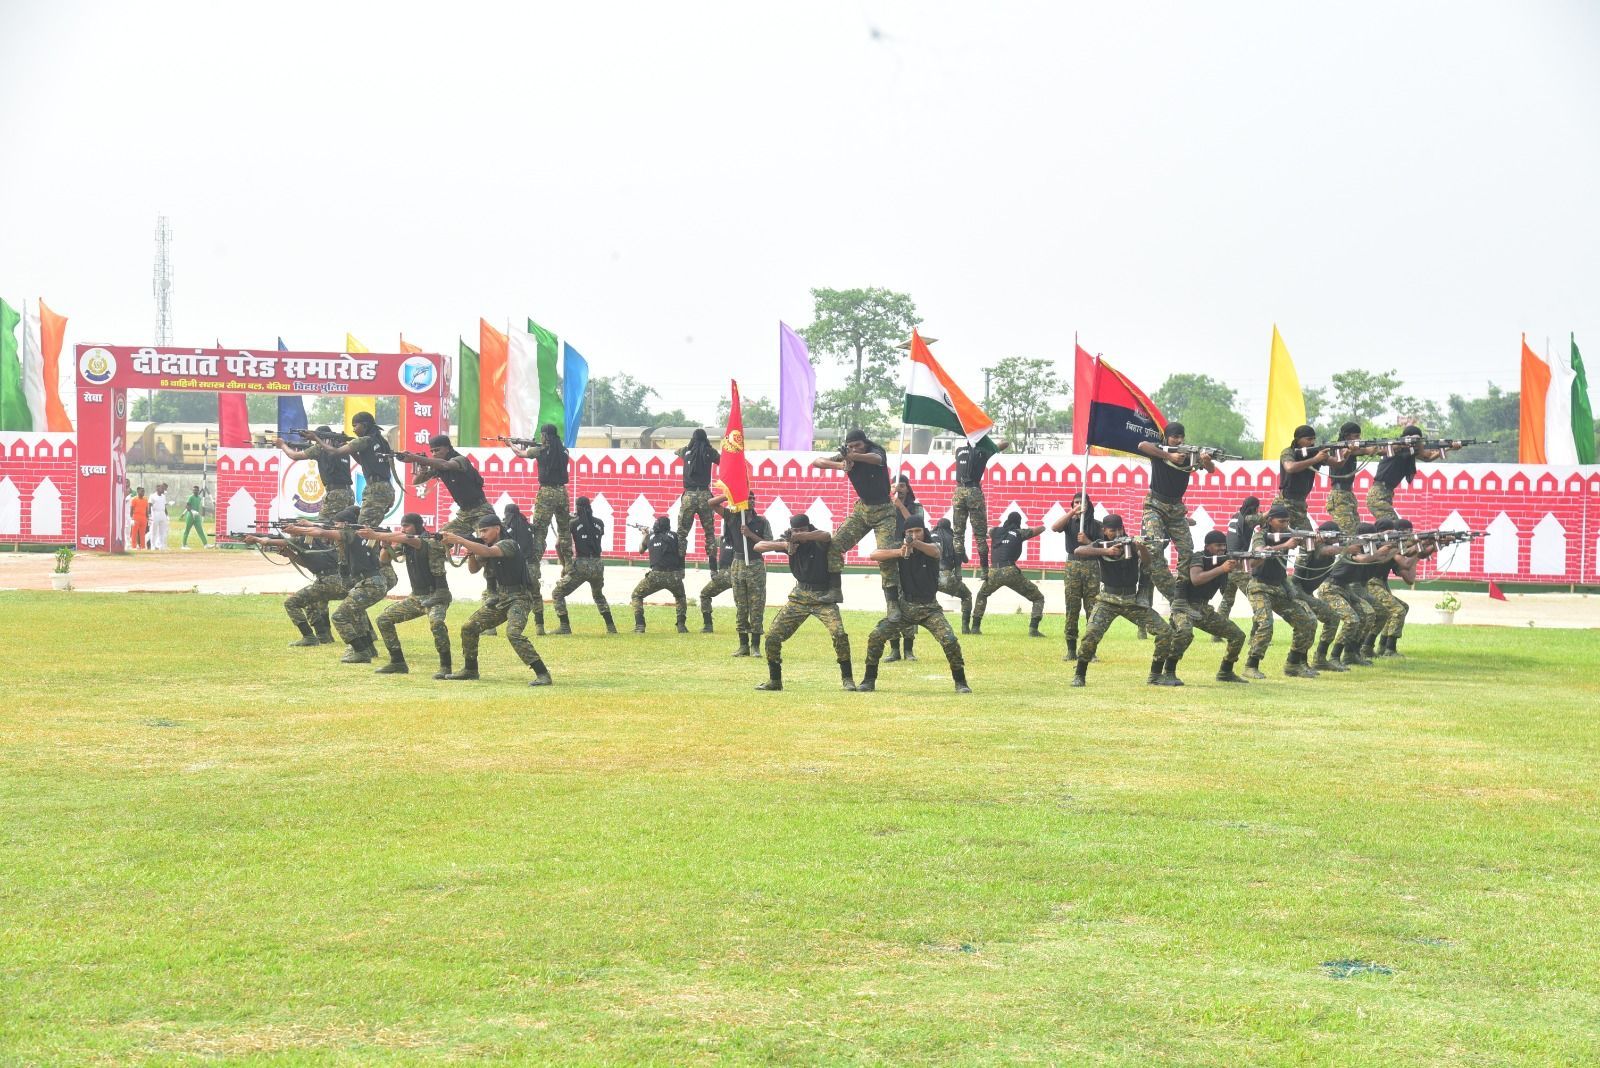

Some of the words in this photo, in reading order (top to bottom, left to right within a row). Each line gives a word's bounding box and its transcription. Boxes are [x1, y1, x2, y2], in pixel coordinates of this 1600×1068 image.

[130, 347, 220, 376] दीक्षांत
[224, 350, 278, 379] परेड
[282, 353, 379, 381] समारोह
[226, 380, 247, 389] सीमा
[293, 381, 319, 391] बिहार
[320, 382, 349, 393] पुलिस
[83, 392, 103, 403] सेवा
[414, 402, 432, 416] देश
[1125, 420, 1143, 433] बिहार
[414, 430, 430, 445] की
[80, 465, 107, 477] सुरक्षा
[80, 534, 105, 548] बंधुत्व
